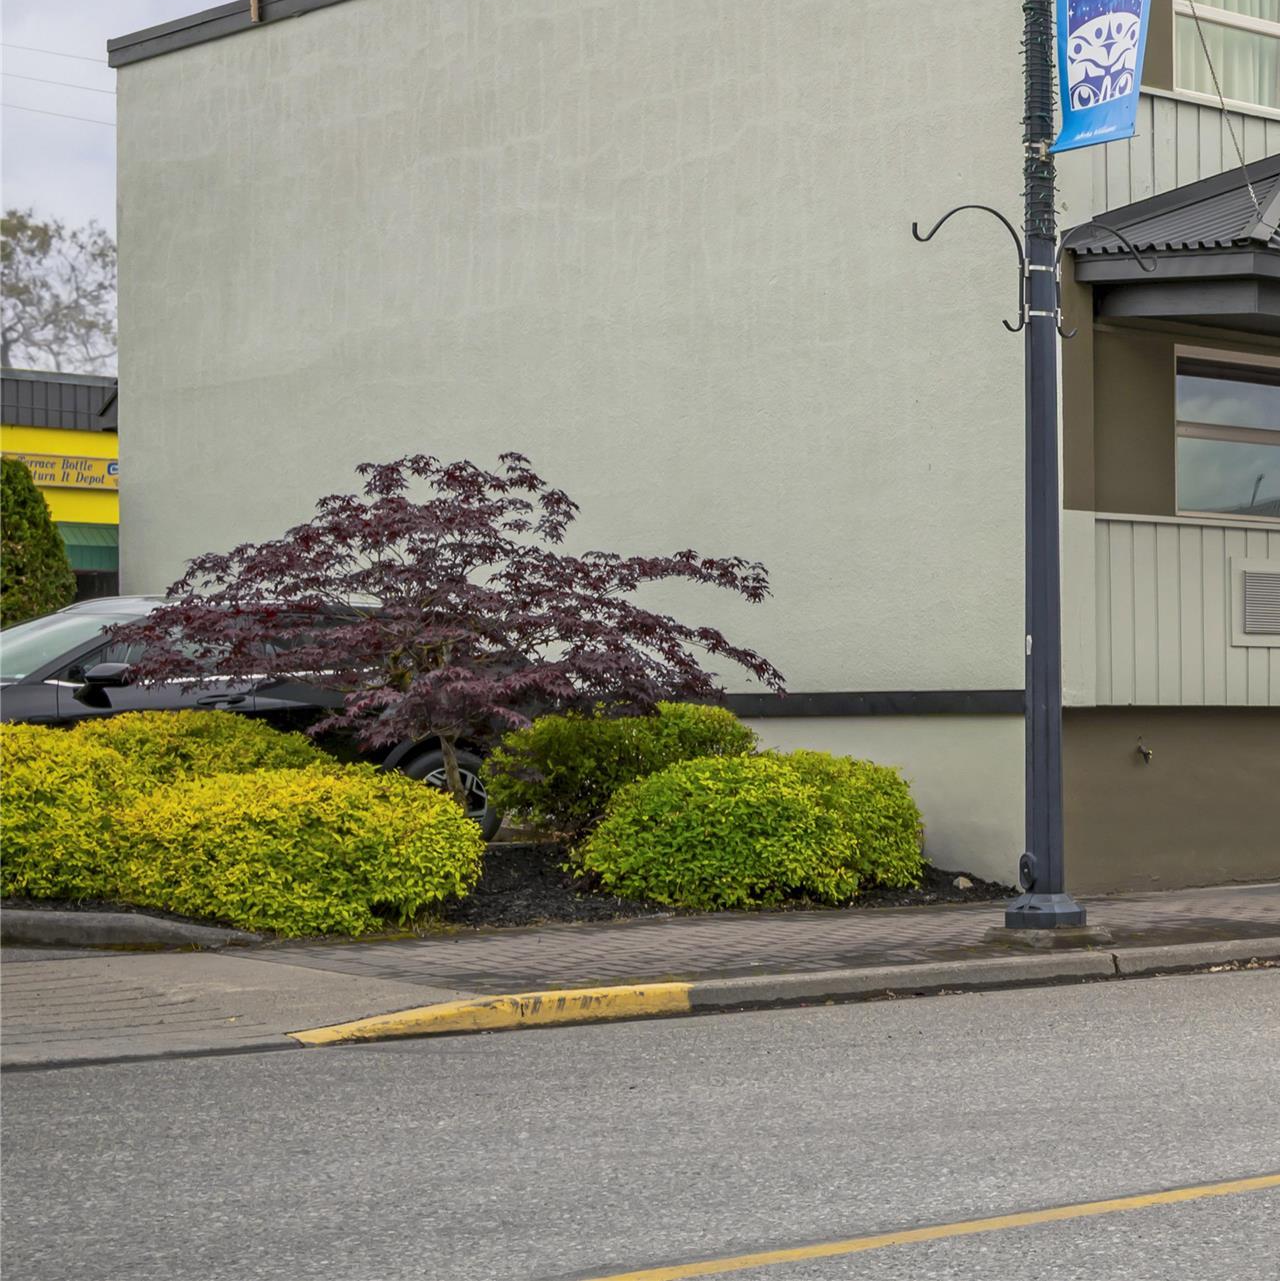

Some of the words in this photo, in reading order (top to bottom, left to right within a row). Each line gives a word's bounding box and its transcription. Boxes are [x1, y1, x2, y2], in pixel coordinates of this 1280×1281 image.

[18, 454, 56, 469] Trrace
[61, 457, 93, 471] Bottle
[33, 469, 56, 481] turn
[61, 471, 69, 482] It
[75, 472, 105, 485] Depot
